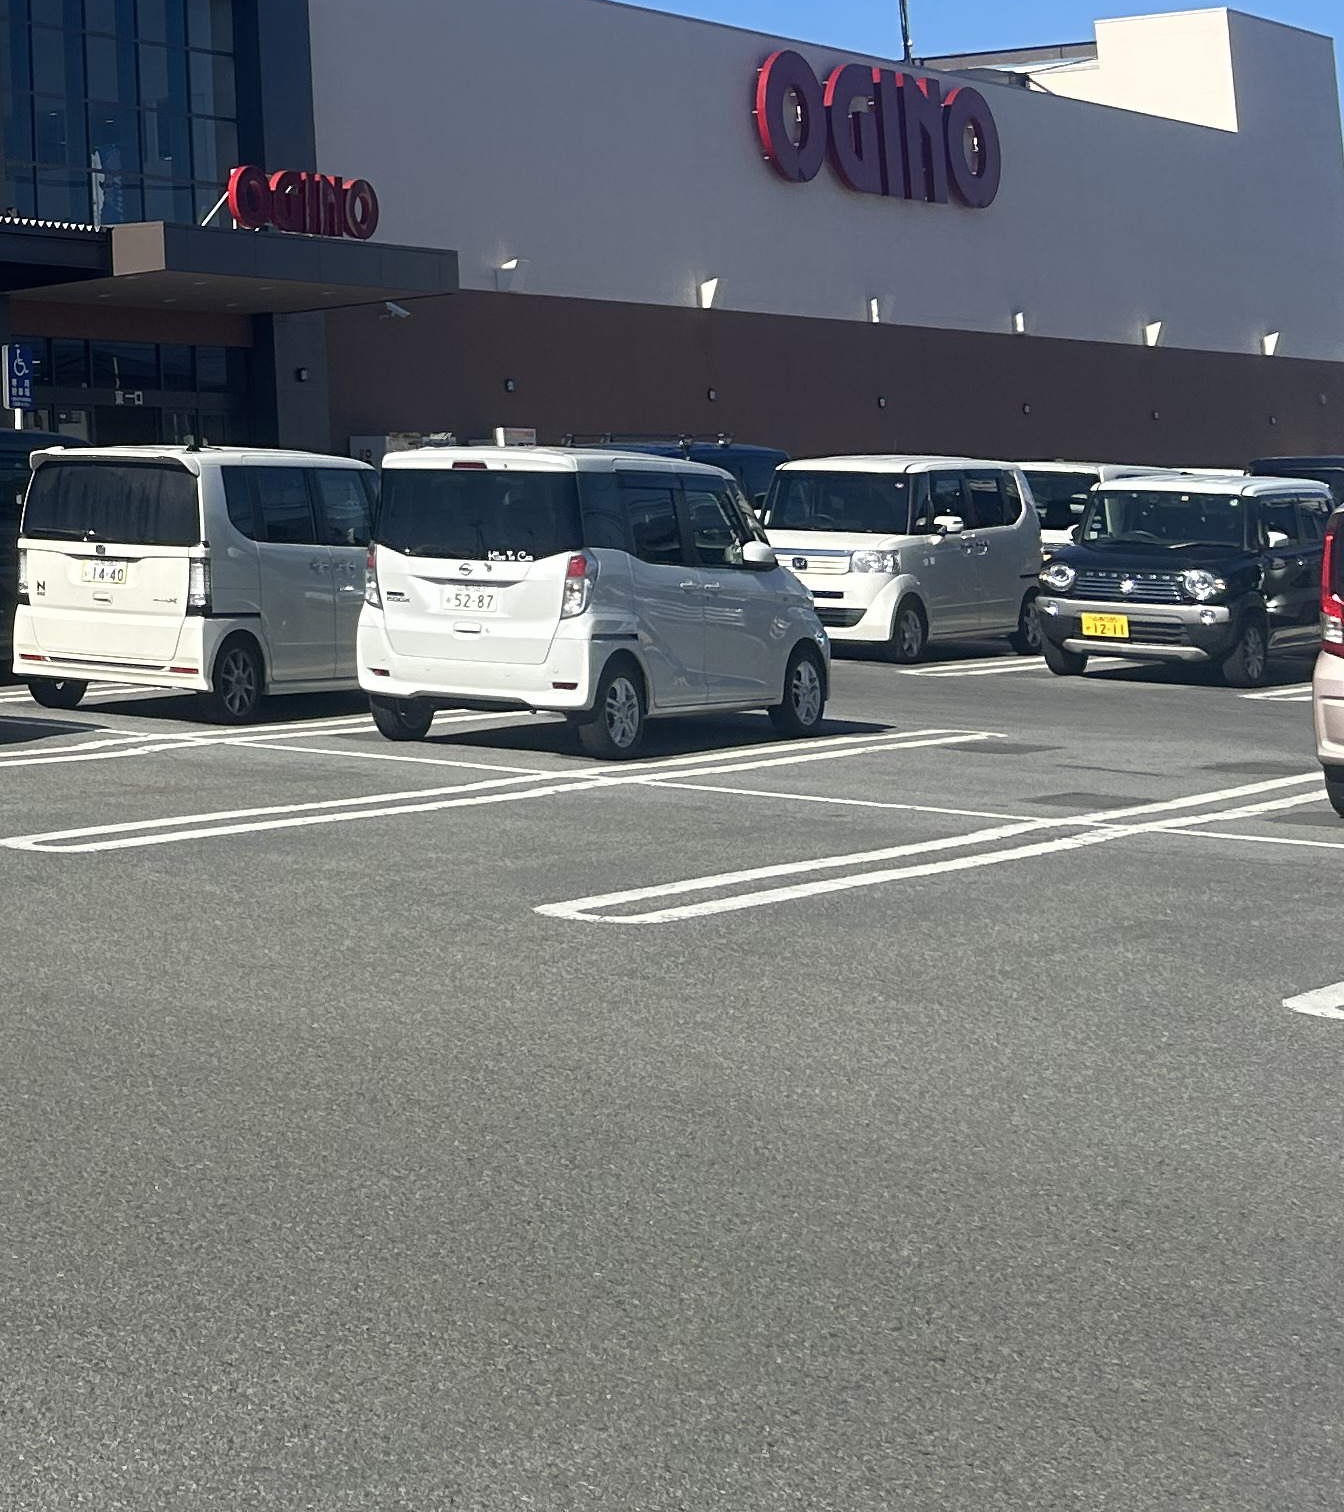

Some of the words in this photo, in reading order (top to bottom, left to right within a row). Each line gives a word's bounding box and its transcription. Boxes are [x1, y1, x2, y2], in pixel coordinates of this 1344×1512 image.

[755, 49, 1002, 209] OGINO
[228, 165, 379, 240] OGINO
[92, 566, 124, 582] 14-40
[36, 580, 46, 592] N
[454, 594, 494, 609] 52-87
[1094, 623, 1124, 636] 12-11
